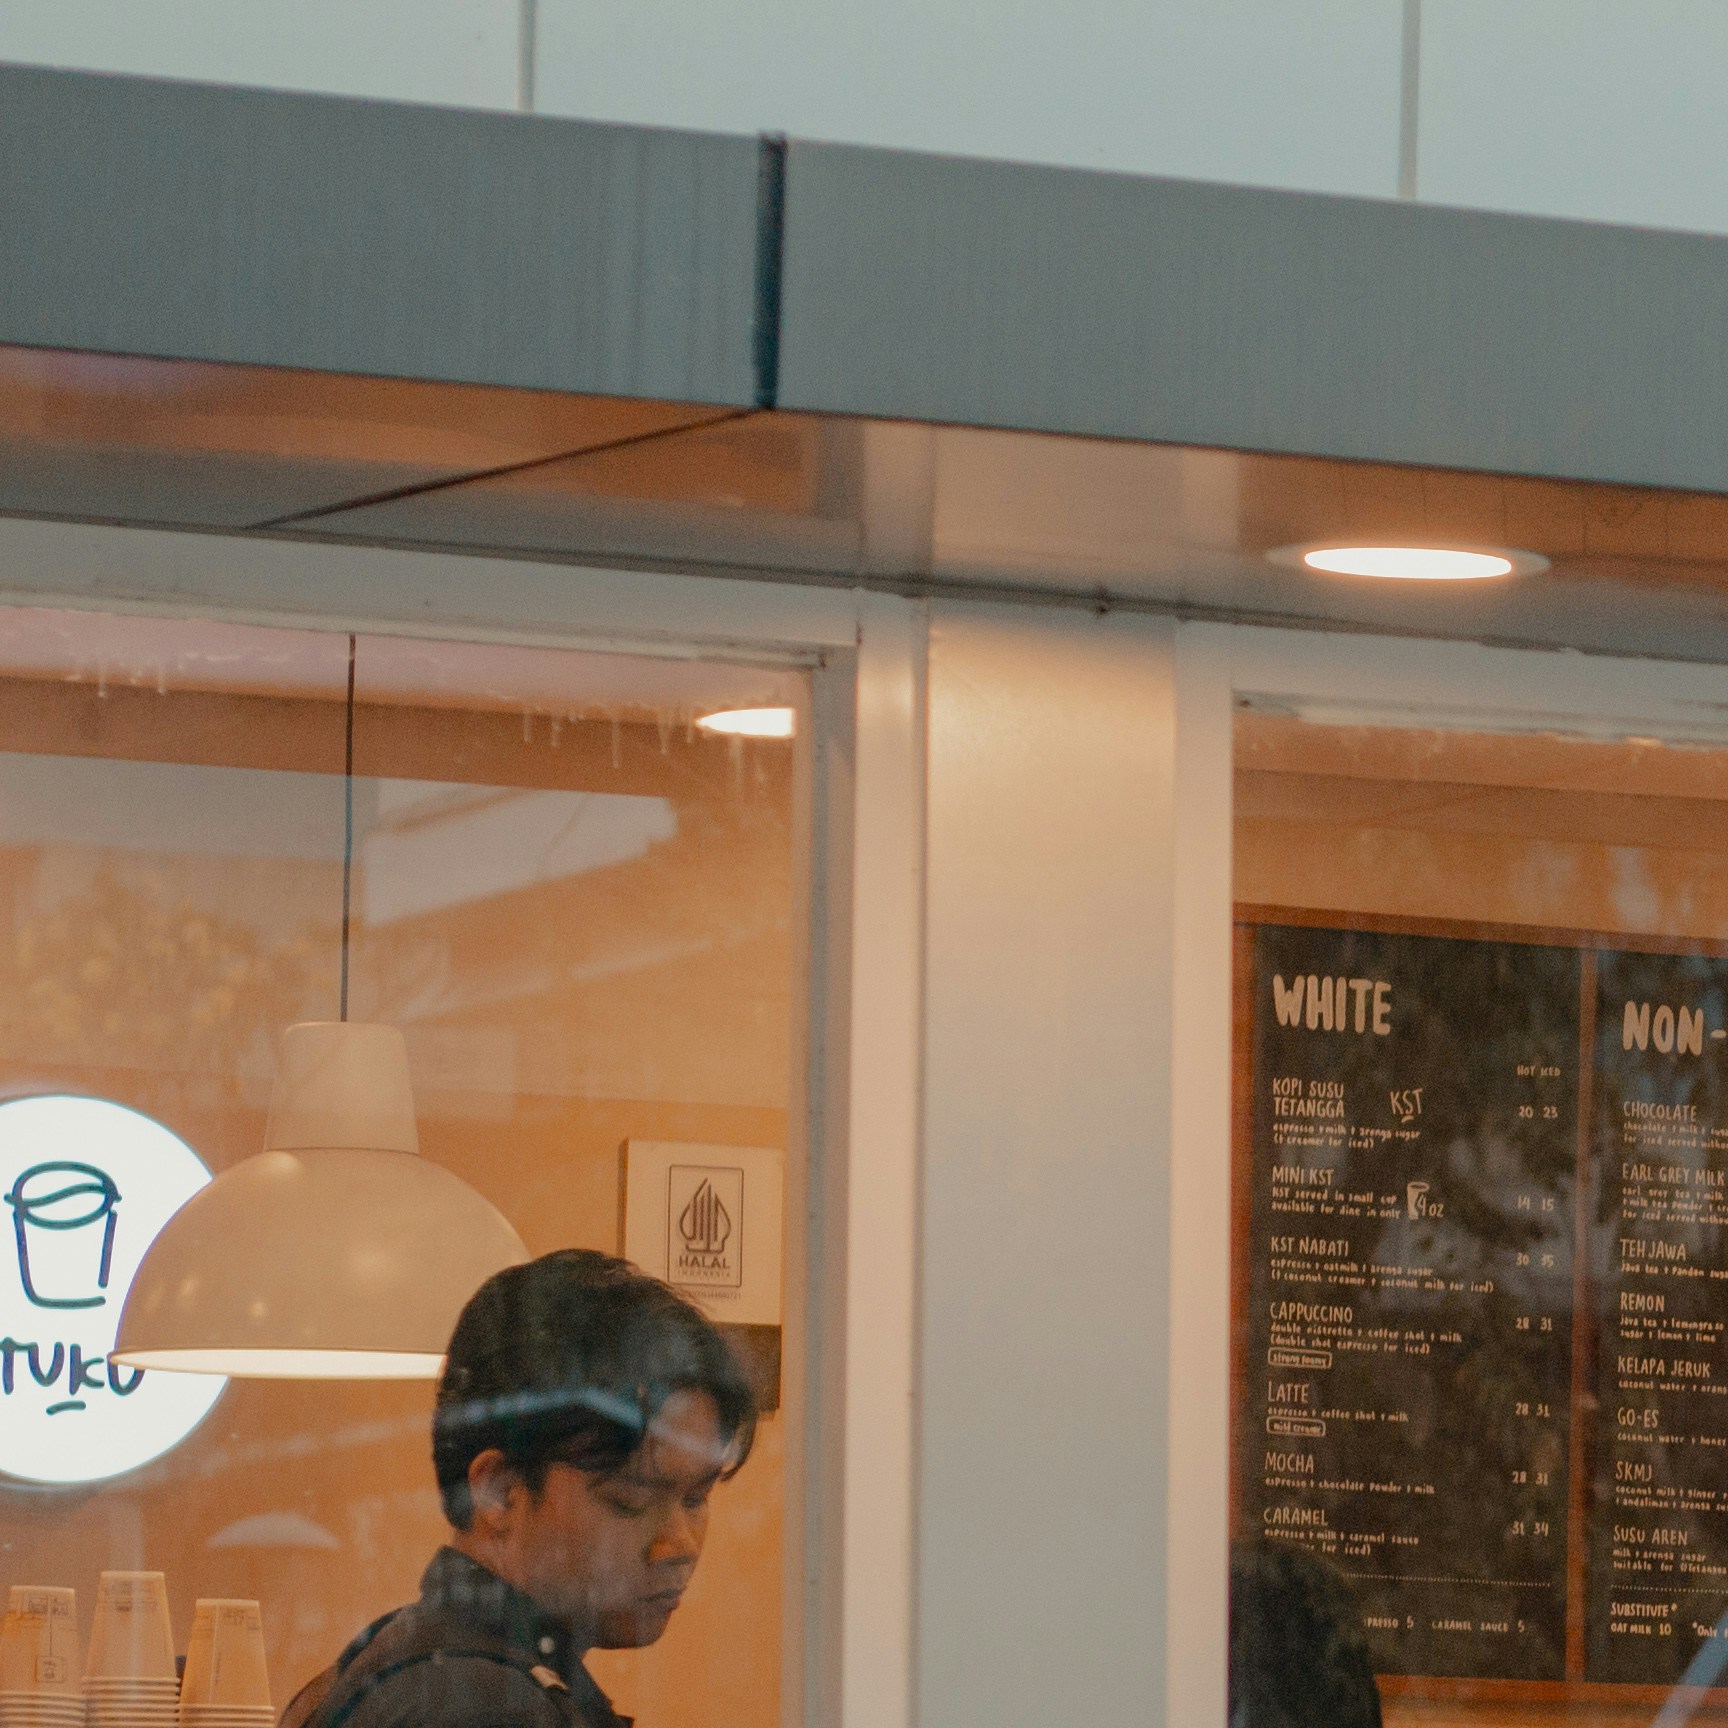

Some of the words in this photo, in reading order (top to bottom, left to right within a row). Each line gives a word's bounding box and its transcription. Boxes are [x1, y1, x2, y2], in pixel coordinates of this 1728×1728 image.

[1273, 974, 1392, 1036] WHITE
[1517, 1065, 1535, 1076] HOT
[1273, 1077, 1302, 1097] KOPI
[1309, 1081, 1344, 1098] SUSU
[1273, 1097, 1344, 1118] TETANGGA
[1390, 1088, 1423, 1116] KST
[1519, 1106, 1534, 1118] 20
[1543, 1106, 1558, 1119] 23
[1624, 1101, 1697, 1122] CHOCOLATE
[1272, 1166, 1304, 1186] MINI
[1309, 1168, 1334, 1186] KST
[1622, 1163, 1652, 1180] EARL
[1660, 1166, 1689, 1184] GREY
[1695, 1169, 1724, 1186] MILK
[1517, 1196, 1531, 1210] 14
[1542, 1198, 1554, 1211] 15
[1271, 1236, 1294, 1252] KST
[1300, 1237, 1349, 1257] NABATI
[1620, 1238, 1644, 1258] TEH
[1649, 1241, 1686, 1260] JAWA
[679, 1255, 731, 1269] HALAL
[1516, 1253, 1529, 1266] 30
[1270, 1301, 1353, 1323] CAPPUCCINO
[1621, 1292, 1664, 1312] REMON
[1617, 1355, 1665, 1375] KELAPA
[1671, 1360, 1710, 1378] JERUK
[1536, 1404, 1550, 1418] 31
[1617, 1407, 1659, 1428] GO-ES
[1265, 1452, 1314, 1474] MOCHA
[1615, 1461, 1652, 1482] SKMJ
[1512, 1471, 1527, 1484] 28
[1535, 1472, 1549, 1485] 31
[1264, 1506, 1328, 1526] CARAMEL
[1512, 1521, 1524, 1535] 31
[1534, 1522, 1548, 1536] 34
[1614, 1525, 1645, 1543] SUSU
[1652, 1529, 1688, 1546] AREN
[1407, 1616, 1414, 1628] 5
[1433, 1620, 1471, 1631] CARAMEL
[1481, 1621, 1509, 1632] SAUCE
[1611, 1622, 1627, 1633] OAT
[1630, 1624, 1651, 1634] MILK
[1660, 1623, 1671, 1635] 10
